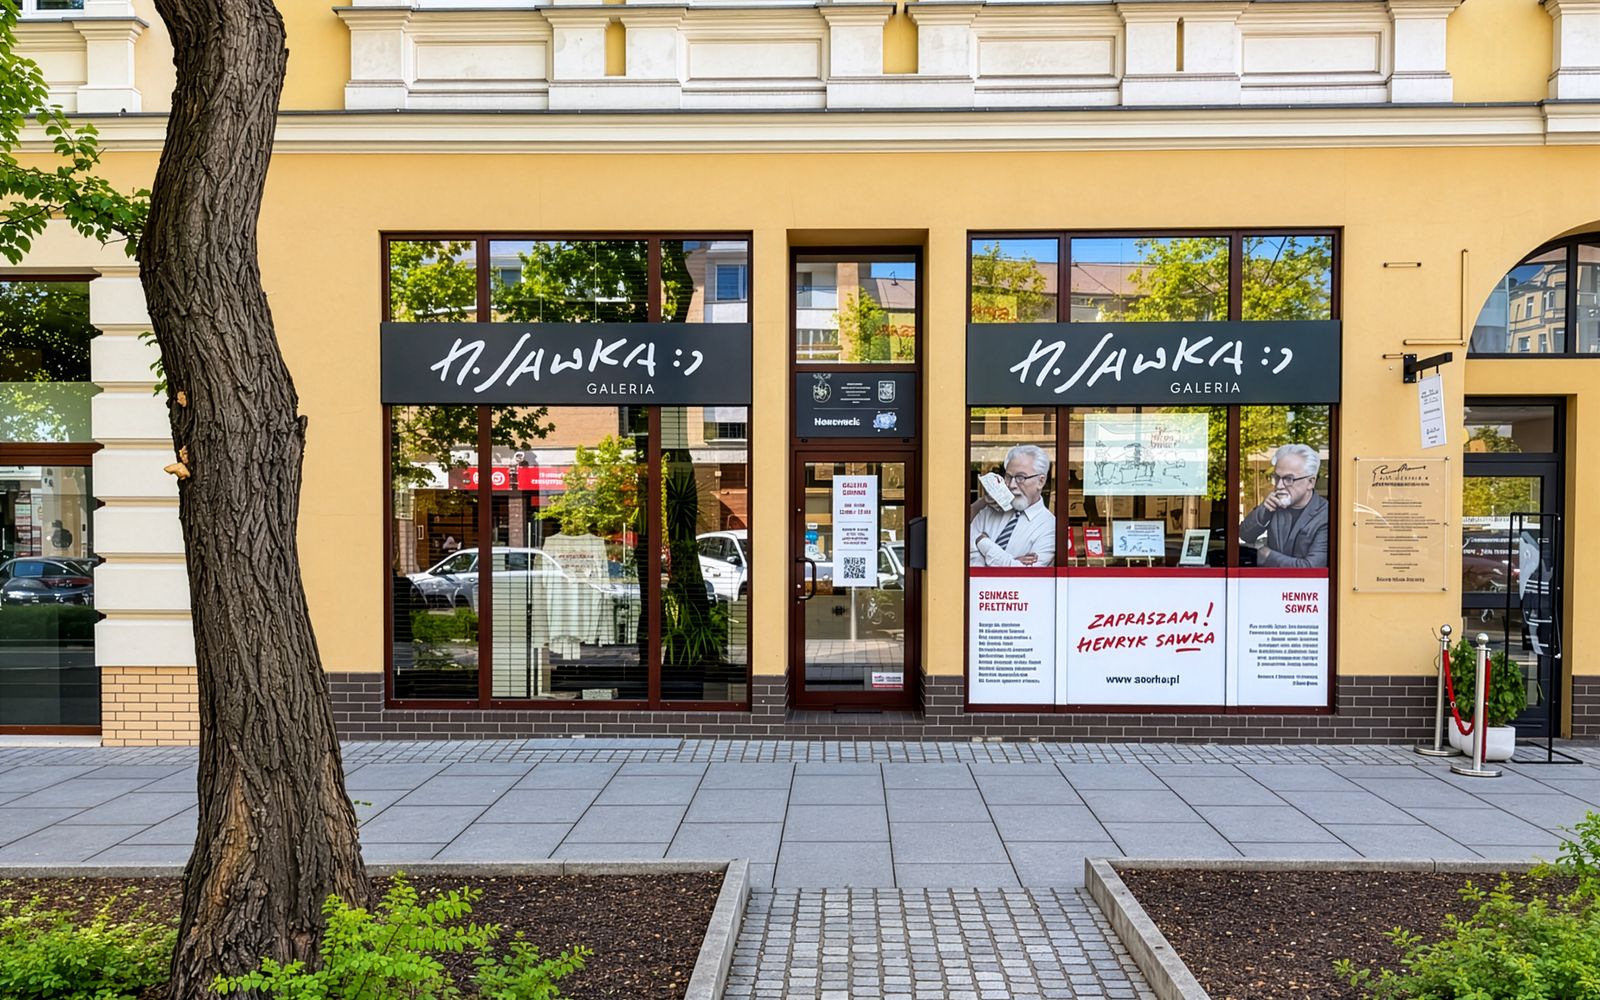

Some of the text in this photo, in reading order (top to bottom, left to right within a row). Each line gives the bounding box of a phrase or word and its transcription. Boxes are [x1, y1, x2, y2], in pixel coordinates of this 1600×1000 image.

[586, 382, 655, 395] GALERIA
[1170, 382, 1241, 394] GALERIA
[1077, 631, 1215, 653] HENRYK SAWKA
